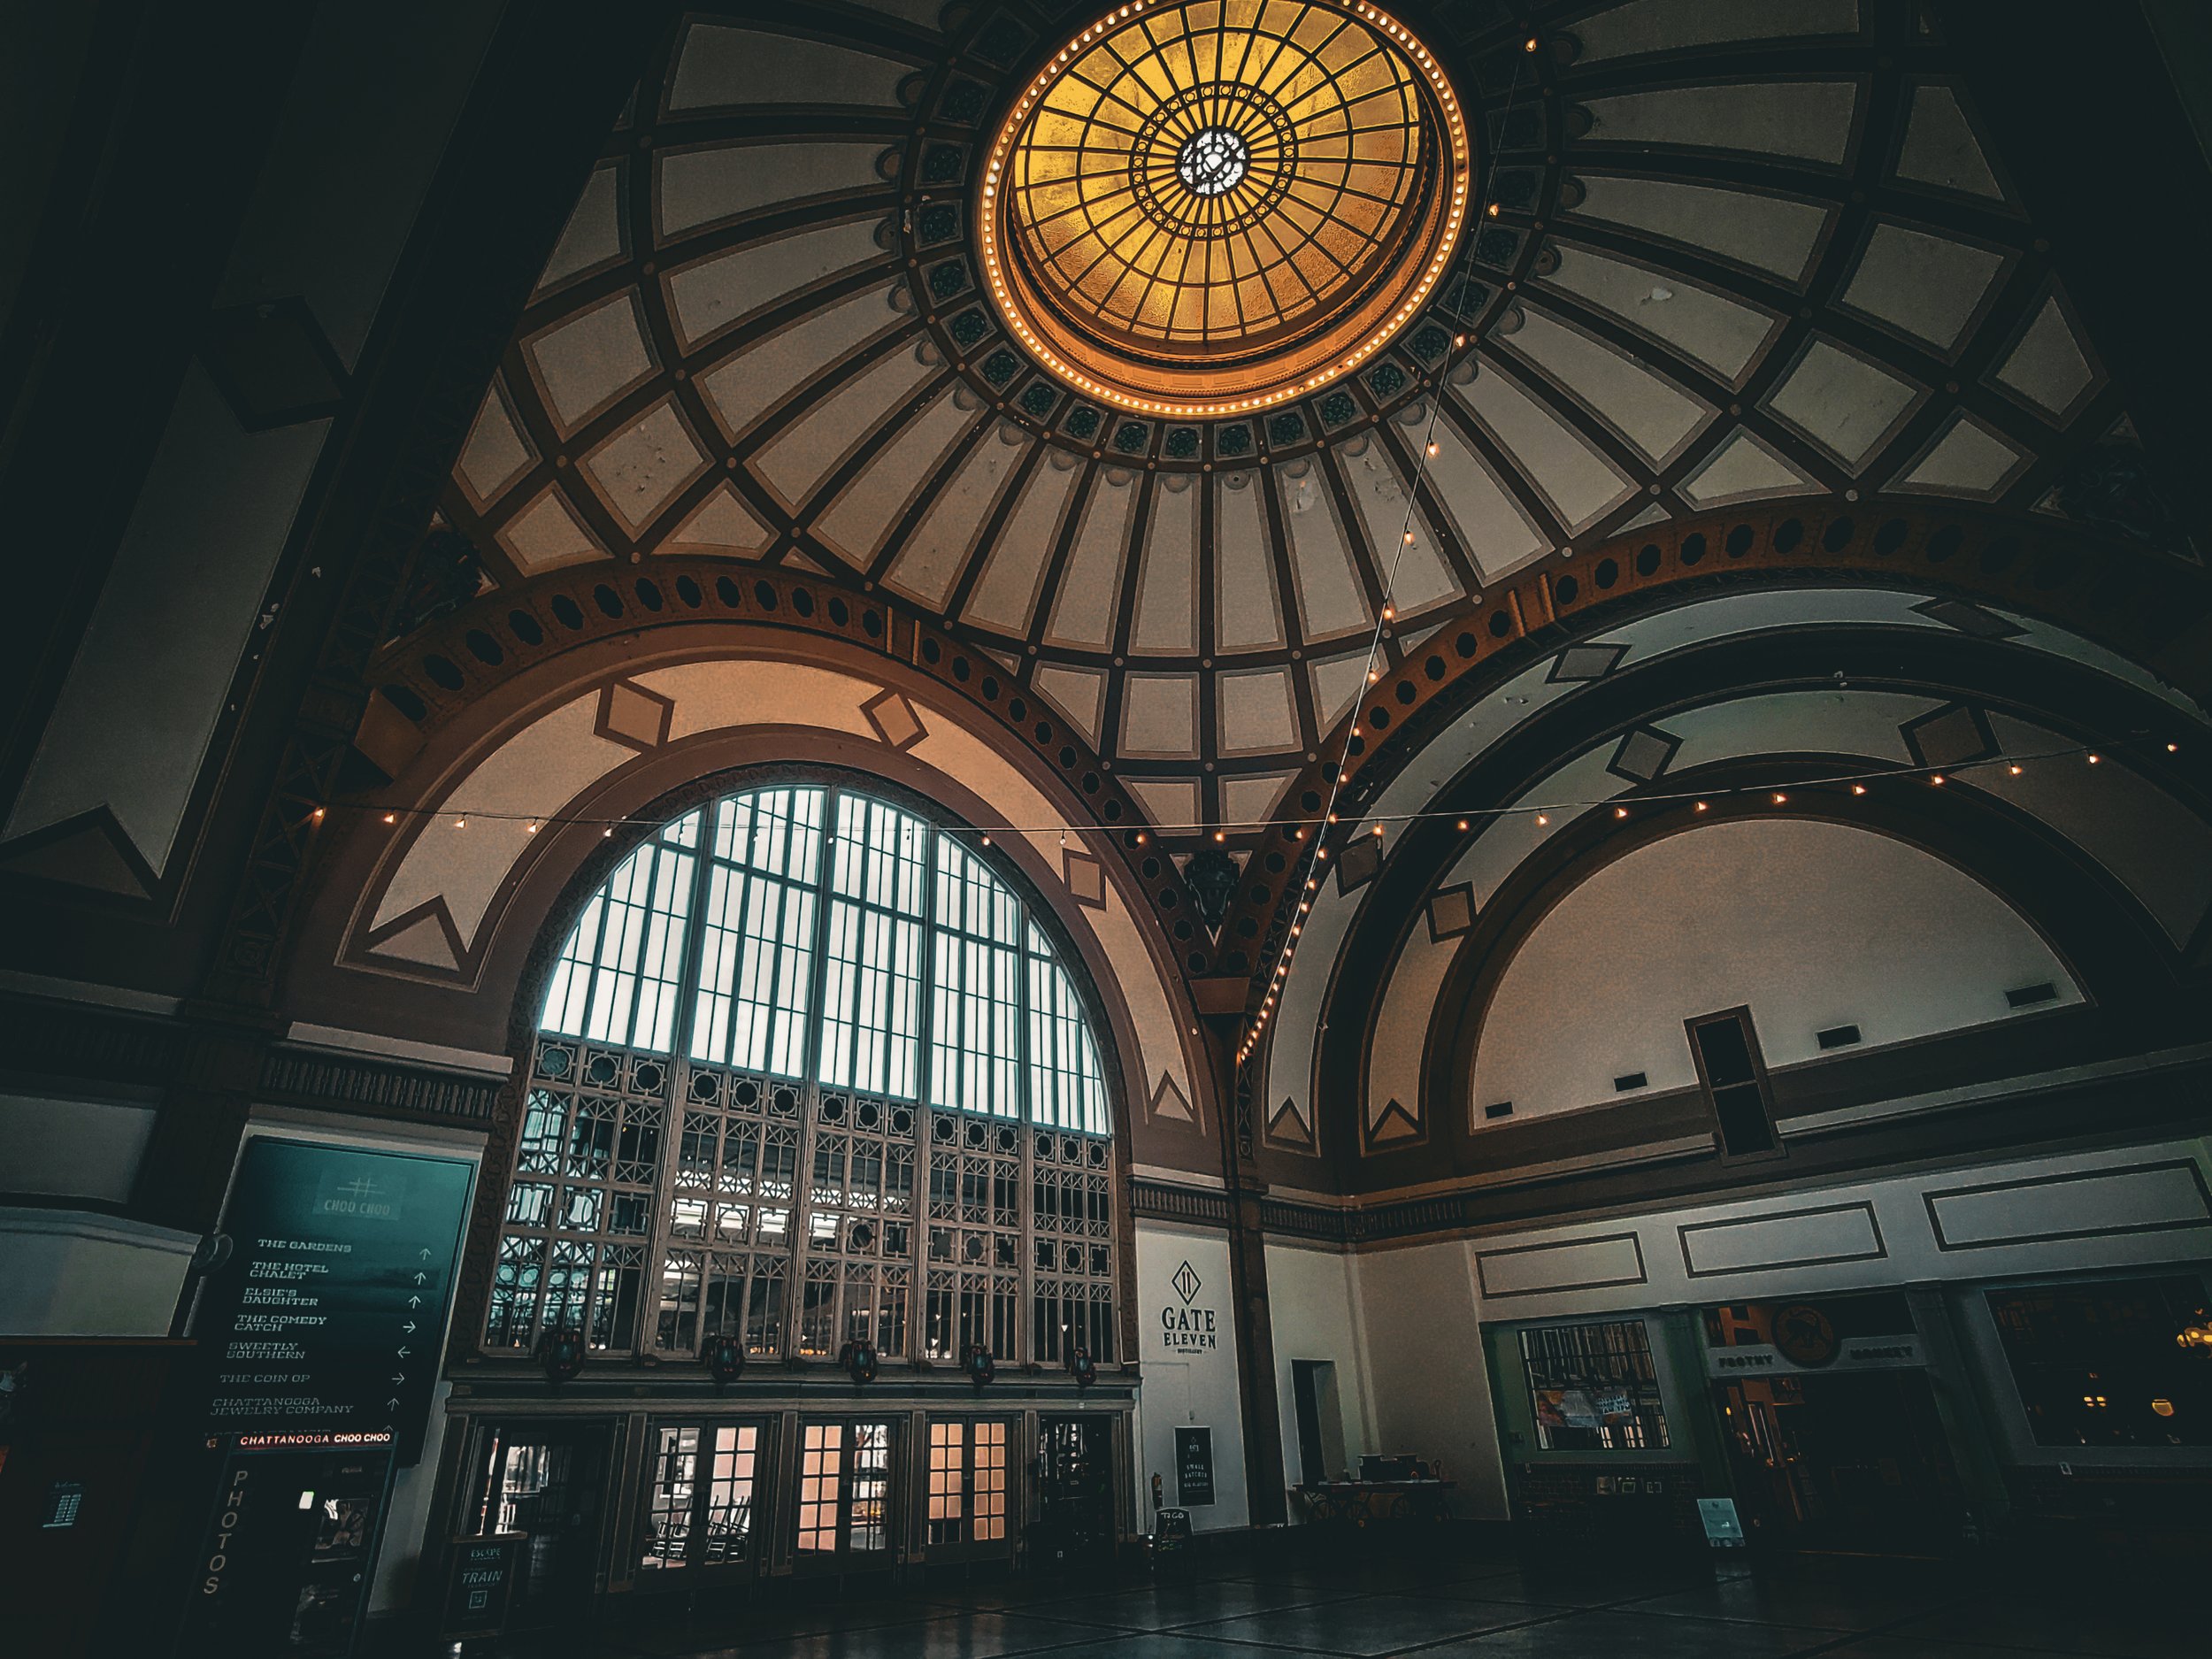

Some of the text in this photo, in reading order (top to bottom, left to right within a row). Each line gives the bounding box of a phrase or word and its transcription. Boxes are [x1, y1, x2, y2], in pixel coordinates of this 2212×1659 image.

[324, 1199, 390, 1216] CHOO CHOO
[257, 1239, 352, 1253] THE GARDENS
[252, 1261, 329, 1273] THE HOTEL
[250, 1270, 307, 1280] CHALET
[243, 1287, 297, 1298] ELSIE'S
[242, 1295, 319, 1306] DAUGHTER
[237, 1314, 327, 1325] THE COMEDY
[1162, 1307, 1216, 1332] GATE
[234, 1323, 282, 1332] CATCH
[228, 1341, 298, 1351] SWEETLY
[1164, 1333, 1217, 1349] ELEVEN
[226, 1350, 305, 1360] SOUTHERN
[1718, 1355, 1773, 1368] FROTHY
[219, 1374, 311, 1383] THE COIN OP
[212, 1398, 320, 1407] CHATTANOOGA
[210, 1405, 355, 1416] JEWELRY COMPANY
[240, 1432, 390, 1446] CHATTANOOGA CHOO CHOO
[204, 1471, 248, 1594] PHOTOS
[462, 1570, 503, 1585] TRAIN
